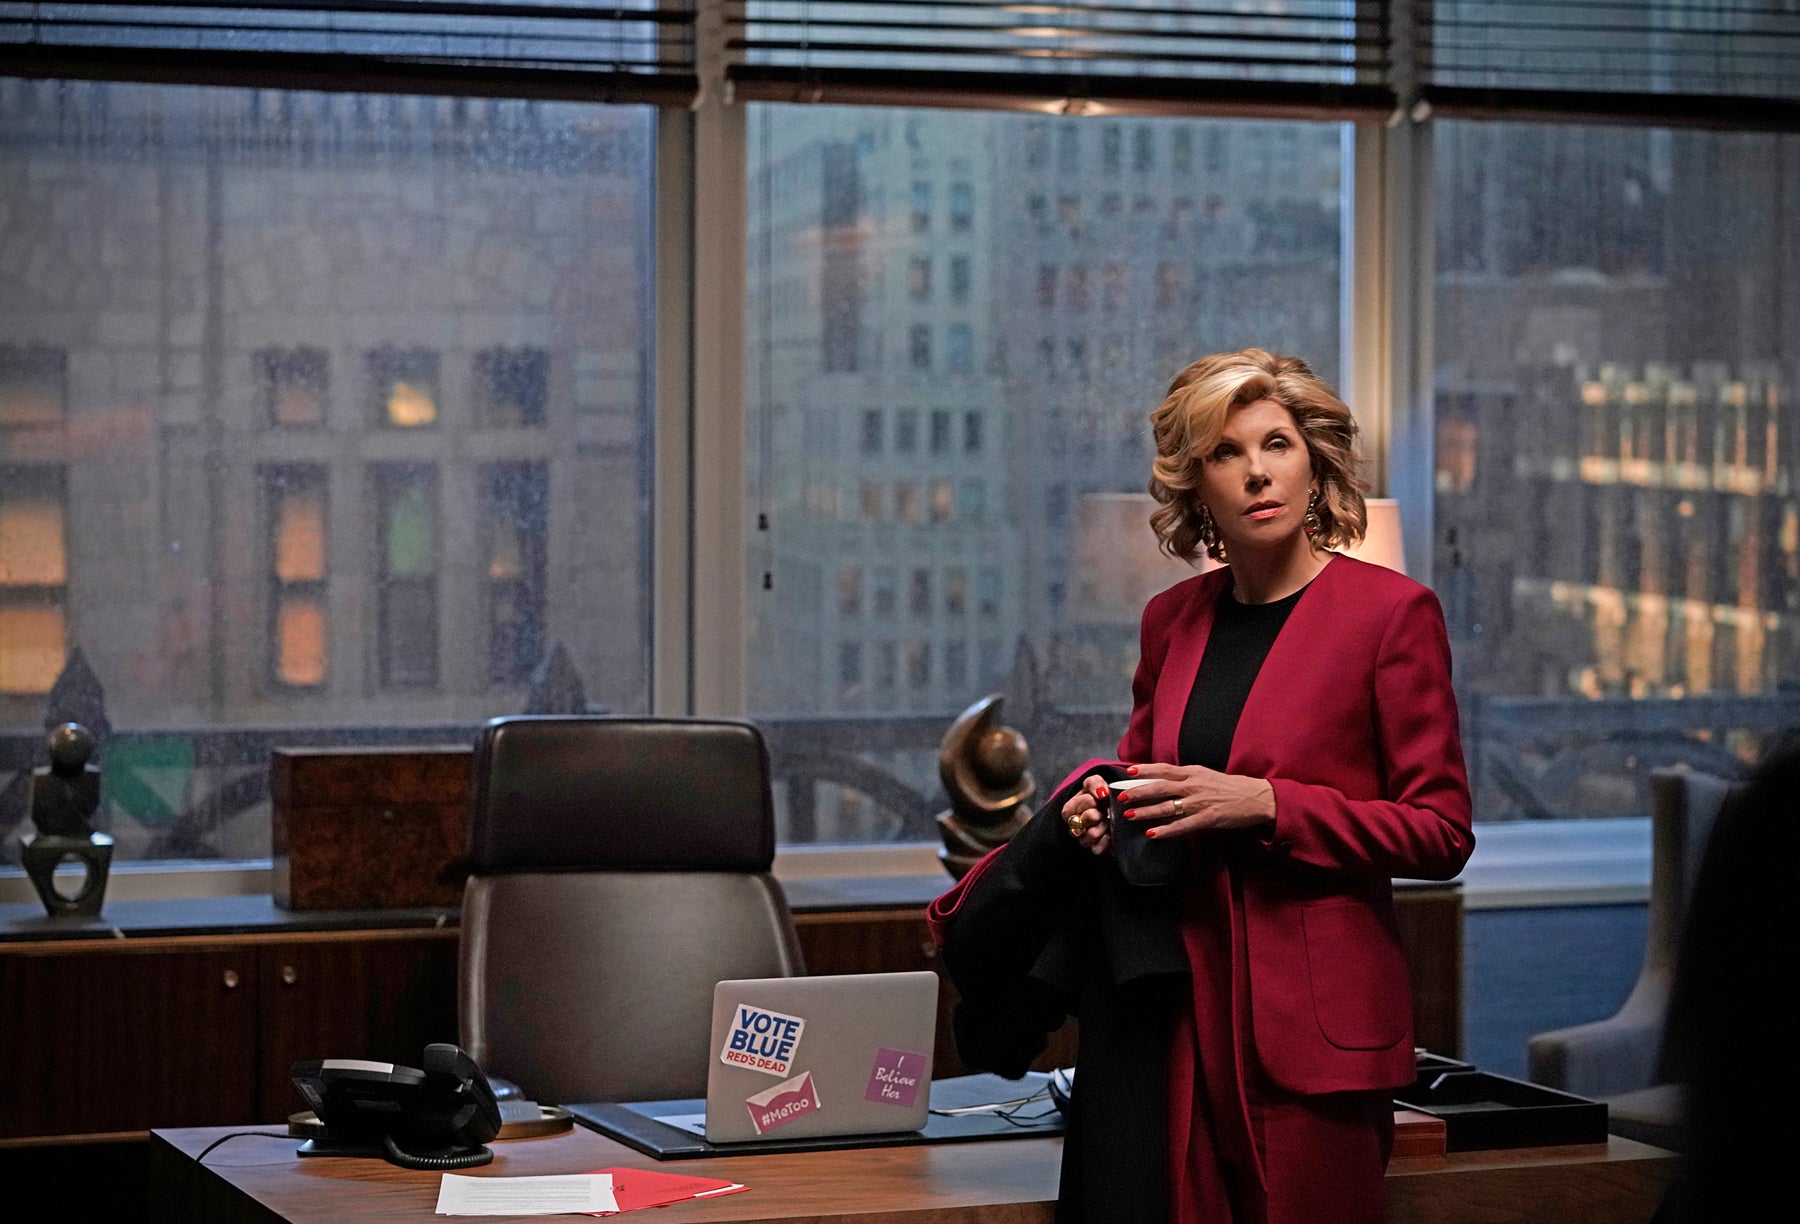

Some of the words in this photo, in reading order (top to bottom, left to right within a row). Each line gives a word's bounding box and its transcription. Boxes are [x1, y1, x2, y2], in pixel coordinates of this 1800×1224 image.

[742, 1009, 800, 1041] VOTE
[730, 1030, 793, 1062] BLUE
[726, 1051, 756, 1065] RED'S
[757, 1059, 786, 1073] DEAD
[875, 1067, 915, 1086] Believe
[881, 1084, 900, 1099] Her
[761, 1099, 809, 1126] #MeToo
